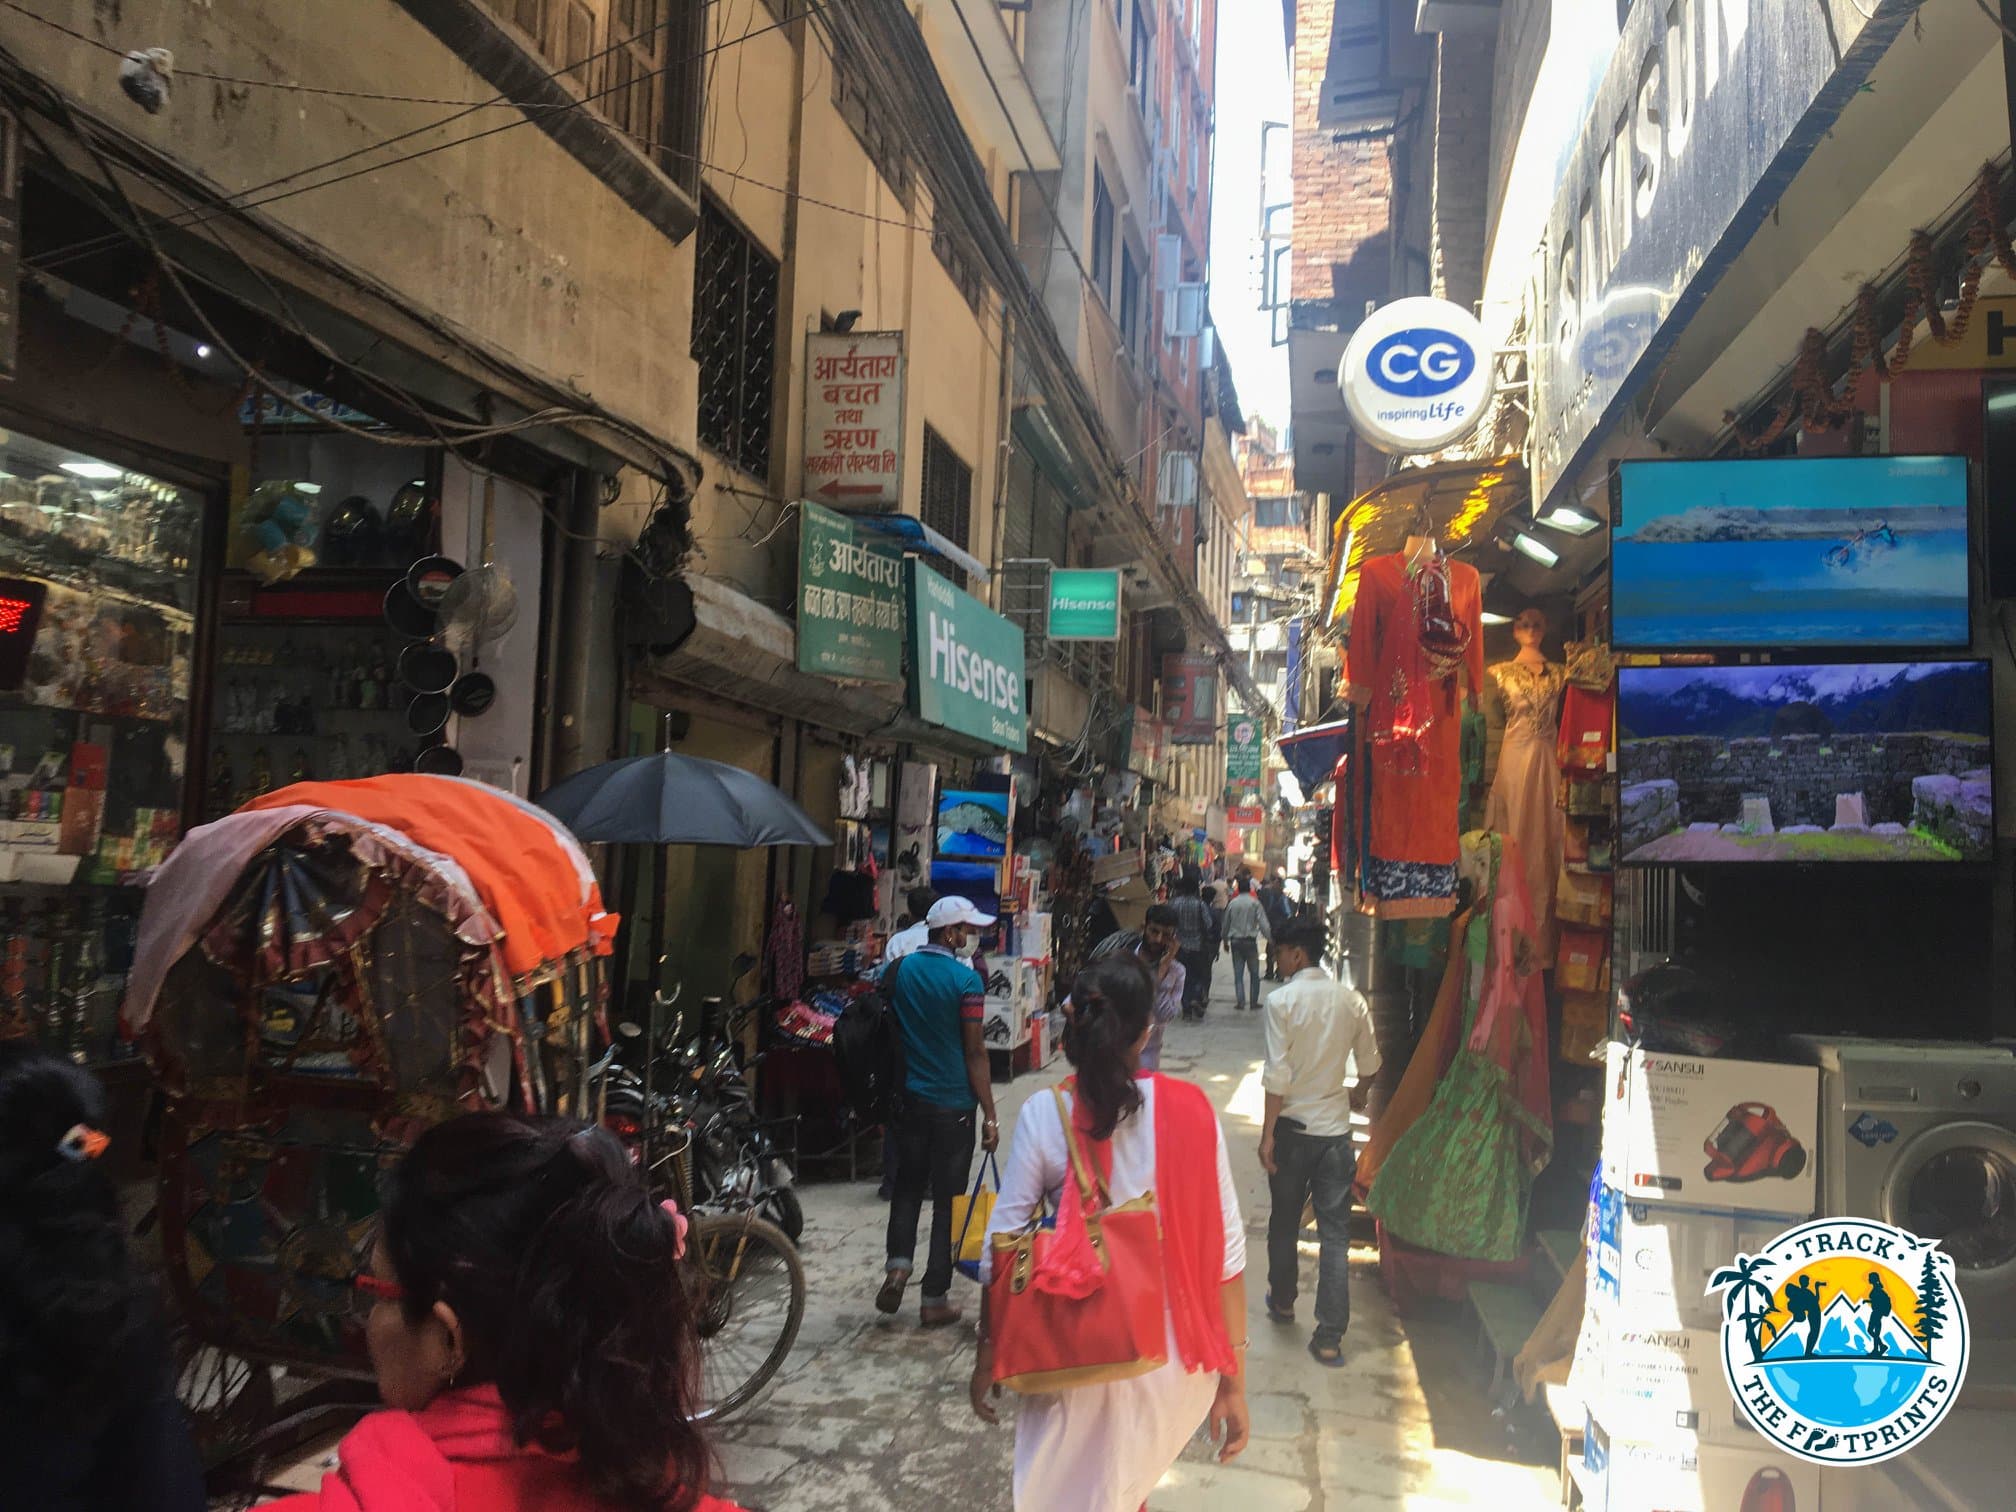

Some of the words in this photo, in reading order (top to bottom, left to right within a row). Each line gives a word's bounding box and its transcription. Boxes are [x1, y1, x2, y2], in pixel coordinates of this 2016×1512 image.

[1380, 342, 1461, 384] CG
[822, 383, 884, 405] बचत
[835, 409, 863, 424] तथा
[823, 429, 880, 449] ऋण
[828, 538, 900, 588] आर्यतारा
[1052, 597, 1116, 611] Hisense
[929, 610, 1019, 715] Hisense
[1655, 1060, 1705, 1075] SANSUI
